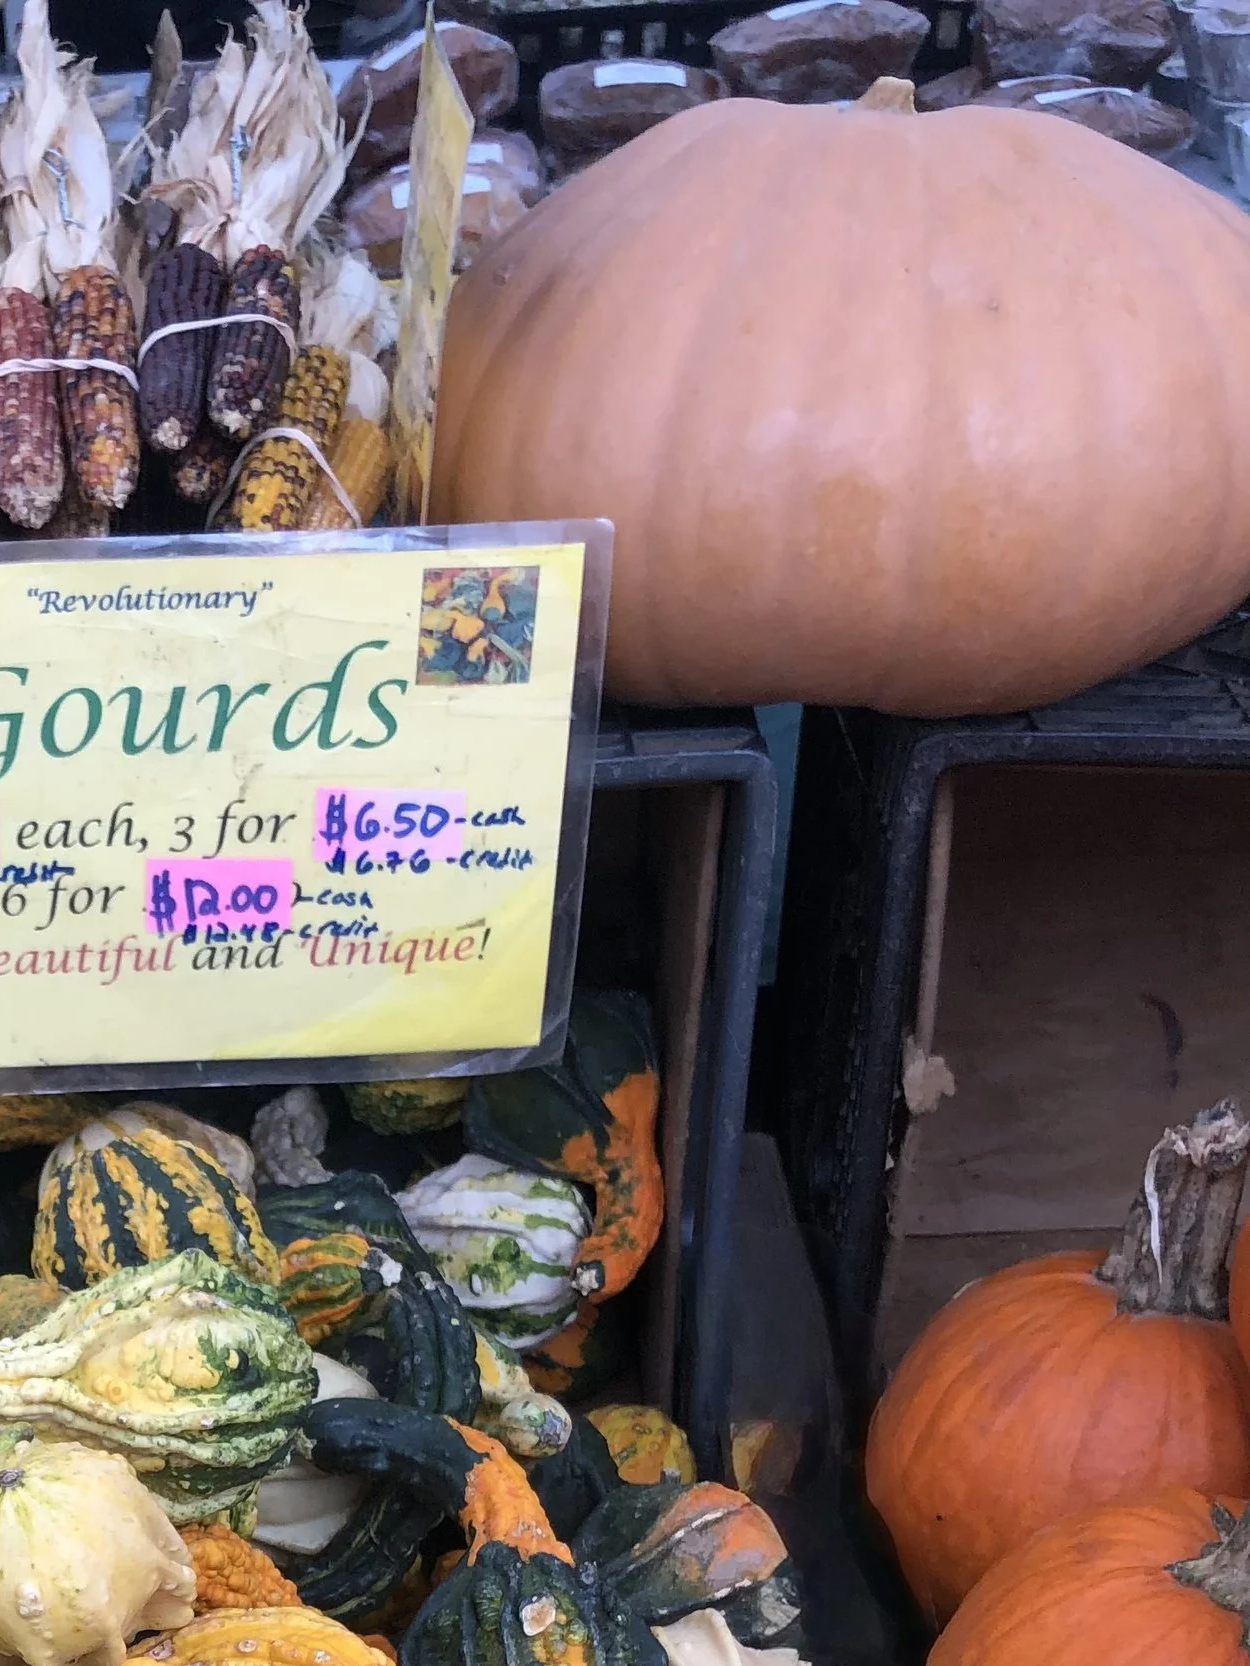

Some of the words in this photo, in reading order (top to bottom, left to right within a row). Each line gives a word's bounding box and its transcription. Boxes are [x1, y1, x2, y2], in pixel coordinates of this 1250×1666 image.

[16, 802, 148, 853] each,
[168, 815, 194, 853] 3
[202, 799, 297, 859] for
[319, 793, 450, 846] $6.50
[1, 882, 28, 917] 6
[34, 874, 126, 931] for
[191, 928, 295, 971] and
[298, 928, 491, 975] Unique!
